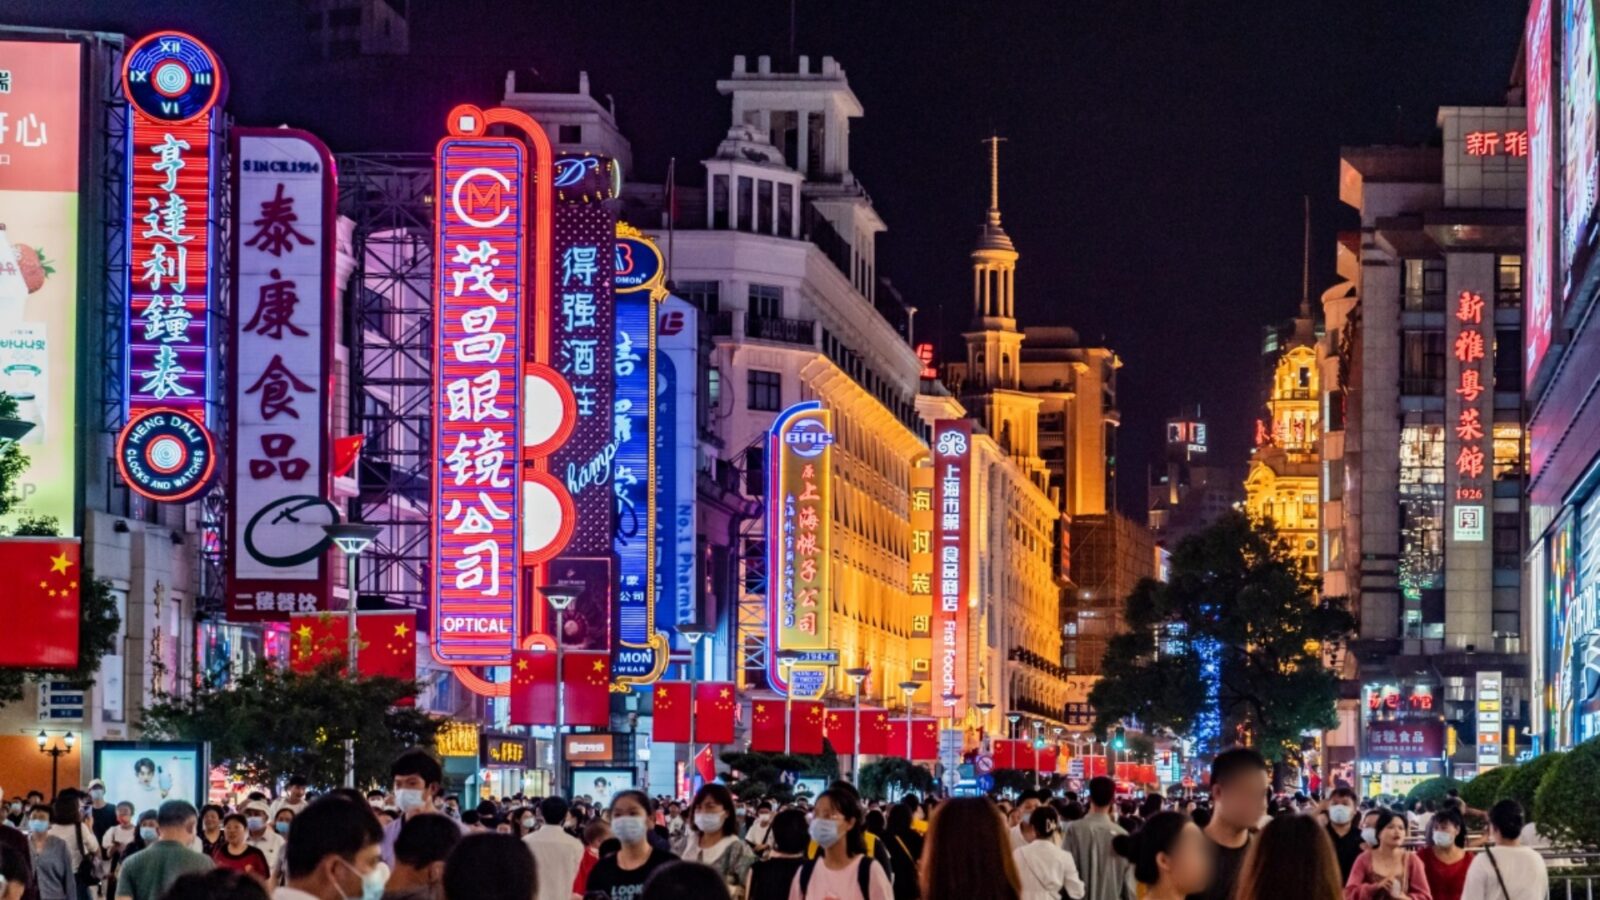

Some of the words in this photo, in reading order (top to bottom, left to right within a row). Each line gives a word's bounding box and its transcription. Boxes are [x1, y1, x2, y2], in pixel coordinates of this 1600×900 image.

[161, 42, 181, 53] XII
[130, 71, 147, 82] IX
[195, 74, 211, 85] III
[162, 102, 179, 114] VI
[243, 183, 317, 480] 泰康食品
[446, 241, 510, 596] 茂昌眼镜公司
[129, 416, 166, 444] HENG
[170, 416, 202, 443] DALI
[126, 448, 150, 484] CLOCKS
[150, 481, 171, 490] AND
[173, 450, 204, 488] WATCHES
[1456, 488, 1483, 500] 1926
[443, 617, 508, 633] OPTICAL
